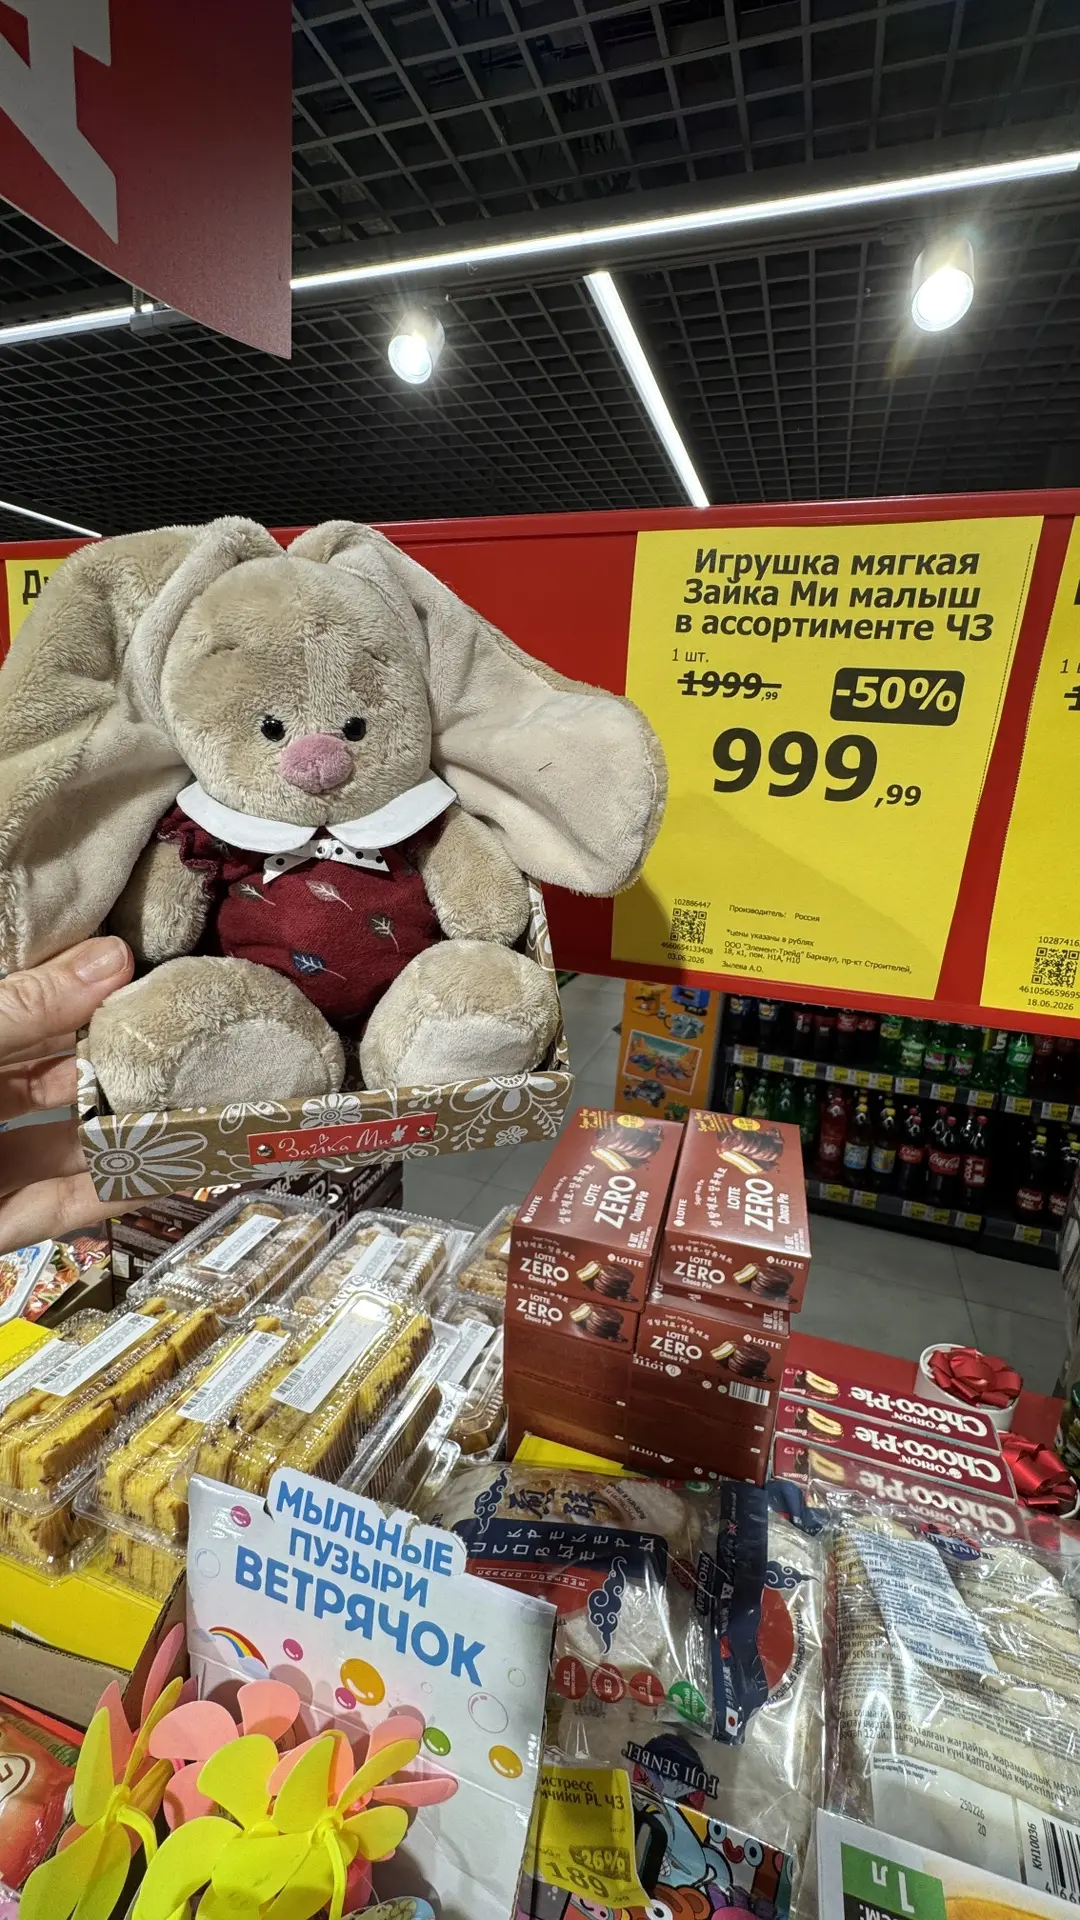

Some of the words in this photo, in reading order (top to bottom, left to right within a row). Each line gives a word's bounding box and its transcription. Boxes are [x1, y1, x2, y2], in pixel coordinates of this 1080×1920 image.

[695, 548, 839, 580] Игрушка
[850, 553, 980, 576] мягкая
[683, 576, 779, 606] Зайка
[790, 580, 839, 607] Ми
[849, 586, 981, 609] малыш
[675, 614, 692, 633] в
[702, 613, 934, 643] ассортименте
[671, 648, 679, 662] 1
[685, 650, 709, 663] шт.
[1060, 659, 1069, 674] 1
[835, 675, 957, 712] -50%
[673, 898, 711, 908] 102886447
[729, 904, 787, 918] Производитель:
[794, 912, 820, 922] Россия
[750, 932, 780, 942] указаны
[788, 937, 815, 947] рублях
[1038, 935, 1080, 947] 10287416
[667, 952, 705, 964] 03.06.2026
[724, 947, 734, 956] 18,
[749, 952, 765, 960] пом.
[724, 940, 741, 949] ООО
[806, 951, 839, 964] Барнаул,
[841, 957, 862, 966] пр-кт
[864, 960, 913, 974] Строителей,
[1027, 998, 1074, 1011] 18.06.2026
[278, 1133, 351, 1158] Зайка
[356, 1128, 394, 1149] Ми
[526, 1194, 543, 1217] LOTTE
[582, 1183, 602, 1207] LOTTE
[593, 1175, 637, 1230] ZERO
[727, 1186, 741, 1210] LOTTE
[744, 1178, 774, 1232] ZERO
[777, 1193, 789, 1204] Pie
[629, 1201, 643, 1222] Choco
[638, 1190, 650, 1202] Pie
[676, 1198, 688, 1220] LOTTE
[777, 1204, 791, 1225] Choco
[534, 1252, 556, 1264] LOTTE
[616, 1255, 644, 1268] LOTTE
[689, 1255, 713, 1267] LOTTE
[775, 1258, 805, 1270] LOTTE
[520, 1257, 570, 1282] ZERO
[673, 1261, 726, 1284] ZERO
[528, 1274, 547, 1285] Choco
[547, 1278, 558, 1287] Pie
[681, 1276, 701, 1287] Choco
[701, 1280, 713, 1290] Pie
[516, 1298, 563, 1321] ZERO
[530, 1293, 551, 1305] LOTTE
[524, 1314, 542, 1324] Choco
[542, 1318, 553, 1327] Pie
[666, 1330, 690, 1343] LOTTE
[752, 1337, 782, 1350] LOTTE
[650, 1335, 703, 1360] ZERO
[659, 1351, 679, 1362] Choco
[679, 1354, 690, 1365] Pie
[894, 1412, 936, 1429] ORION
[901, 1454, 947, 1475] ORION
[275, 1480, 454, 1577] МЫЛЬНЫЕ
[288, 1527, 429, 1608] ПУЗЫРИ
[235, 1545, 486, 1688] ВЕТРЯЧОК
[626, 1742, 680, 1778] SENBEI
[685, 1765, 718, 1796] FUJI
[1053, 1780, 1080, 1799] мерзі
[585, 1792, 602, 1808] PL
[960, 1798, 985, 1820] 250226
[898, 1870, 915, 1914] 1
[1060, 1888, 1080, 1905] 66
